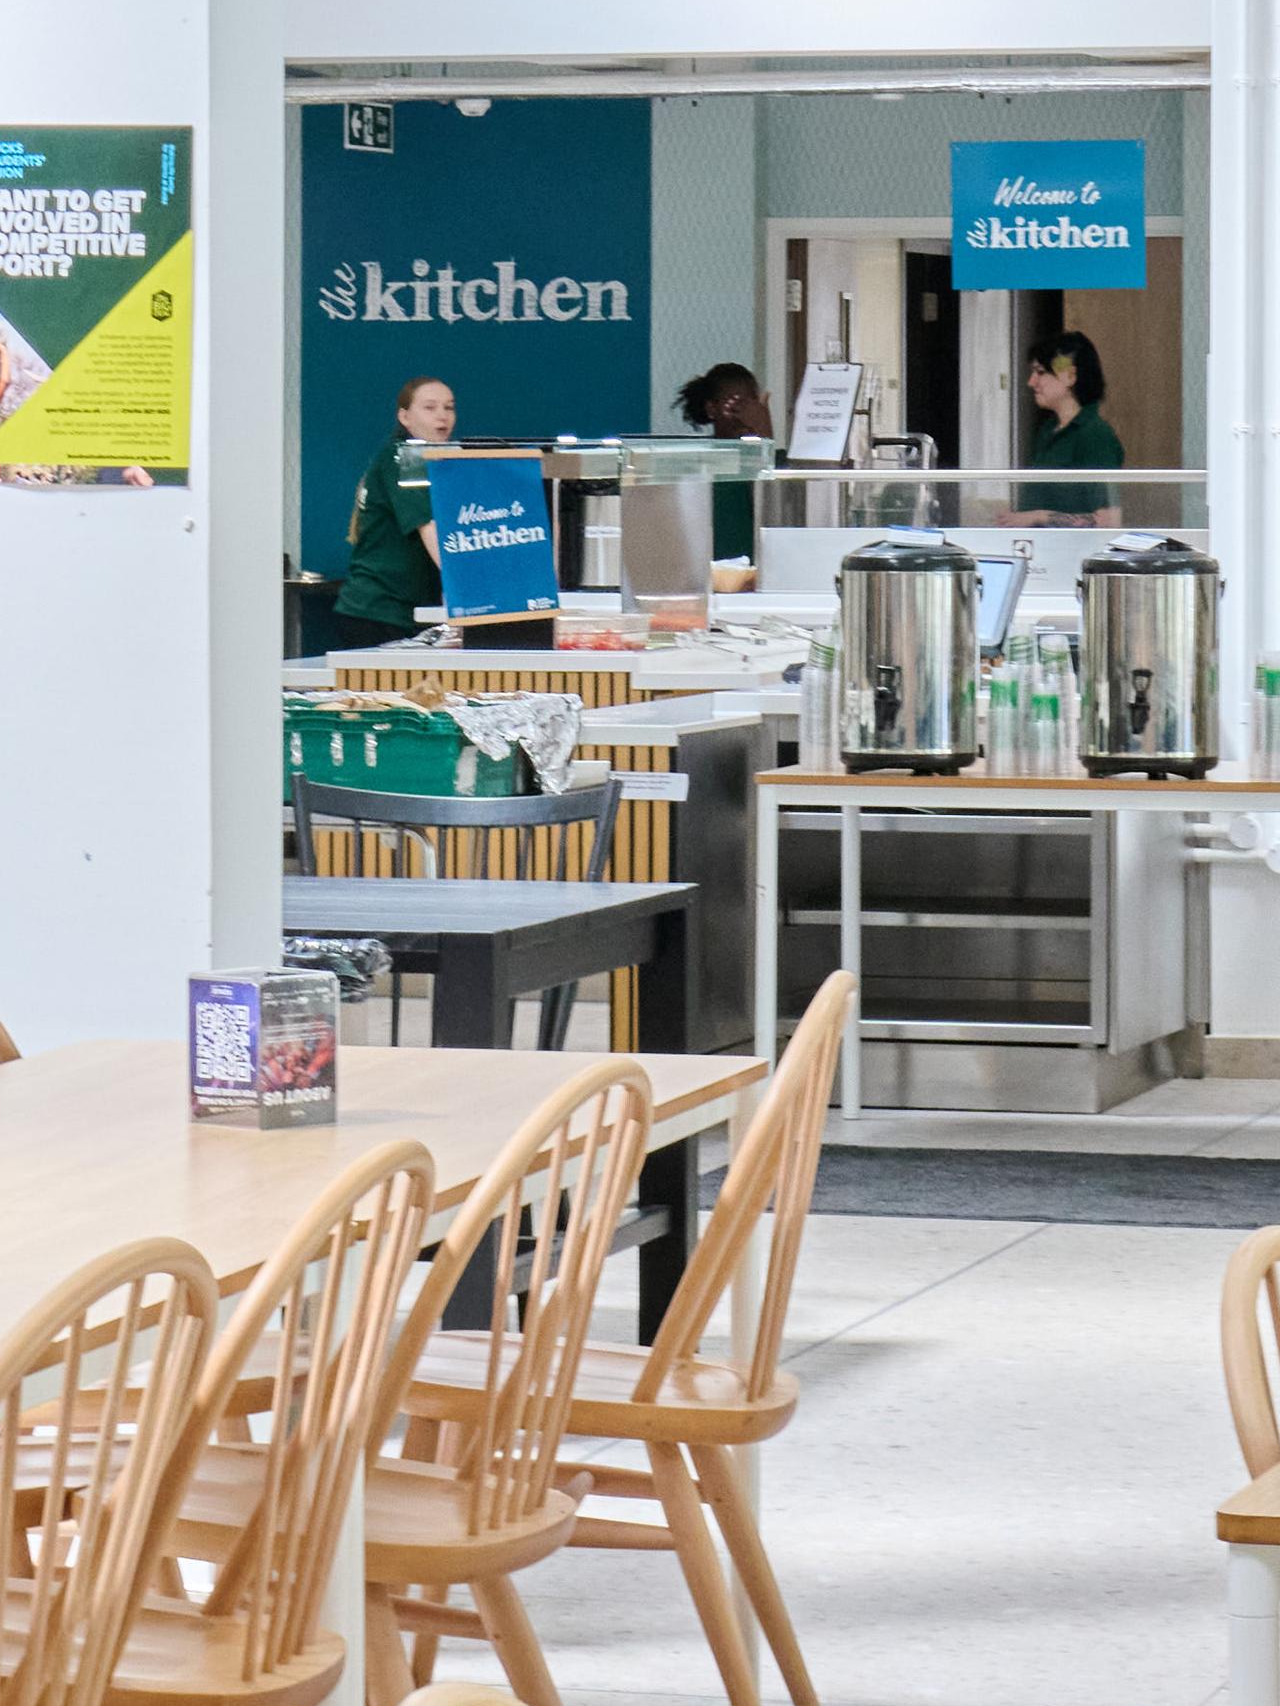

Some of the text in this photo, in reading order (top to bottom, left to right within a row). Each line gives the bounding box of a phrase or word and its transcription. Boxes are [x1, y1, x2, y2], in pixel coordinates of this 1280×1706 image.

[52, 189, 90, 211] TO
[93, 190, 146, 213] GET
[993, 176, 1102, 208] Welcome to
[102, 212, 131, 234] IN
[966, 216, 1131, 250] the kitchen
[319, 257, 632, 323] the kitchen
[457, 502, 510, 525] Welcome
[456, 524, 547, 552] kitchen
